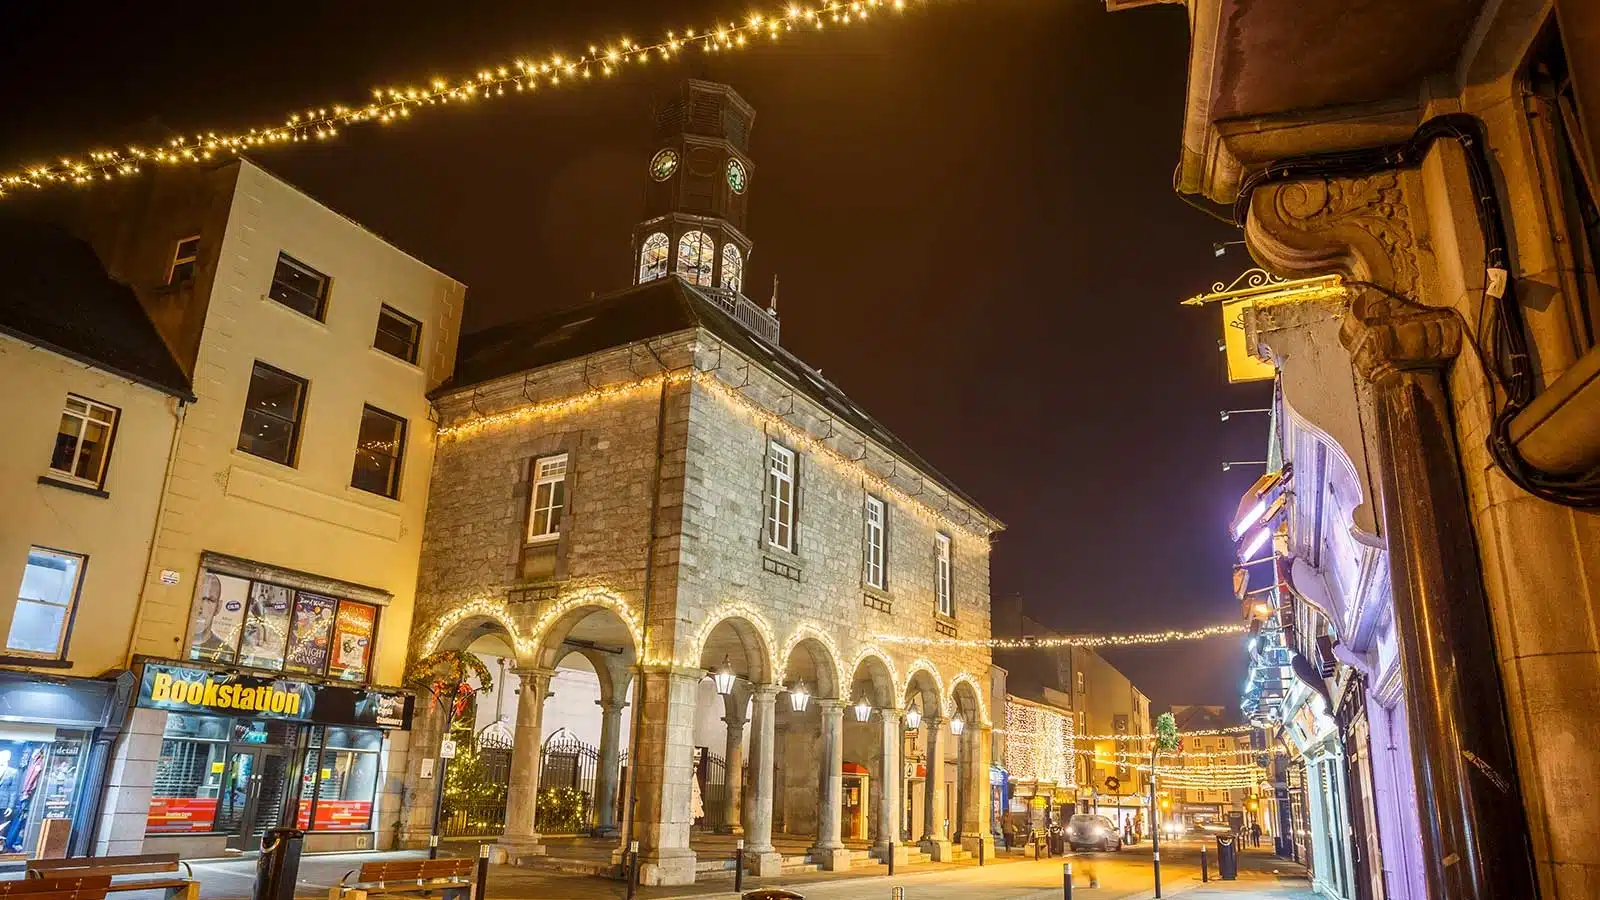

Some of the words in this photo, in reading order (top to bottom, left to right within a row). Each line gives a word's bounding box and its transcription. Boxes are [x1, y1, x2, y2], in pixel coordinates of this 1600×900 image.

[295, 653, 317, 665] GANG
[152, 673, 300, 715] Bookstation
[375, 716, 404, 727] Stationery
[56, 746, 79, 756] detail
[46, 811, 65, 819] detail
